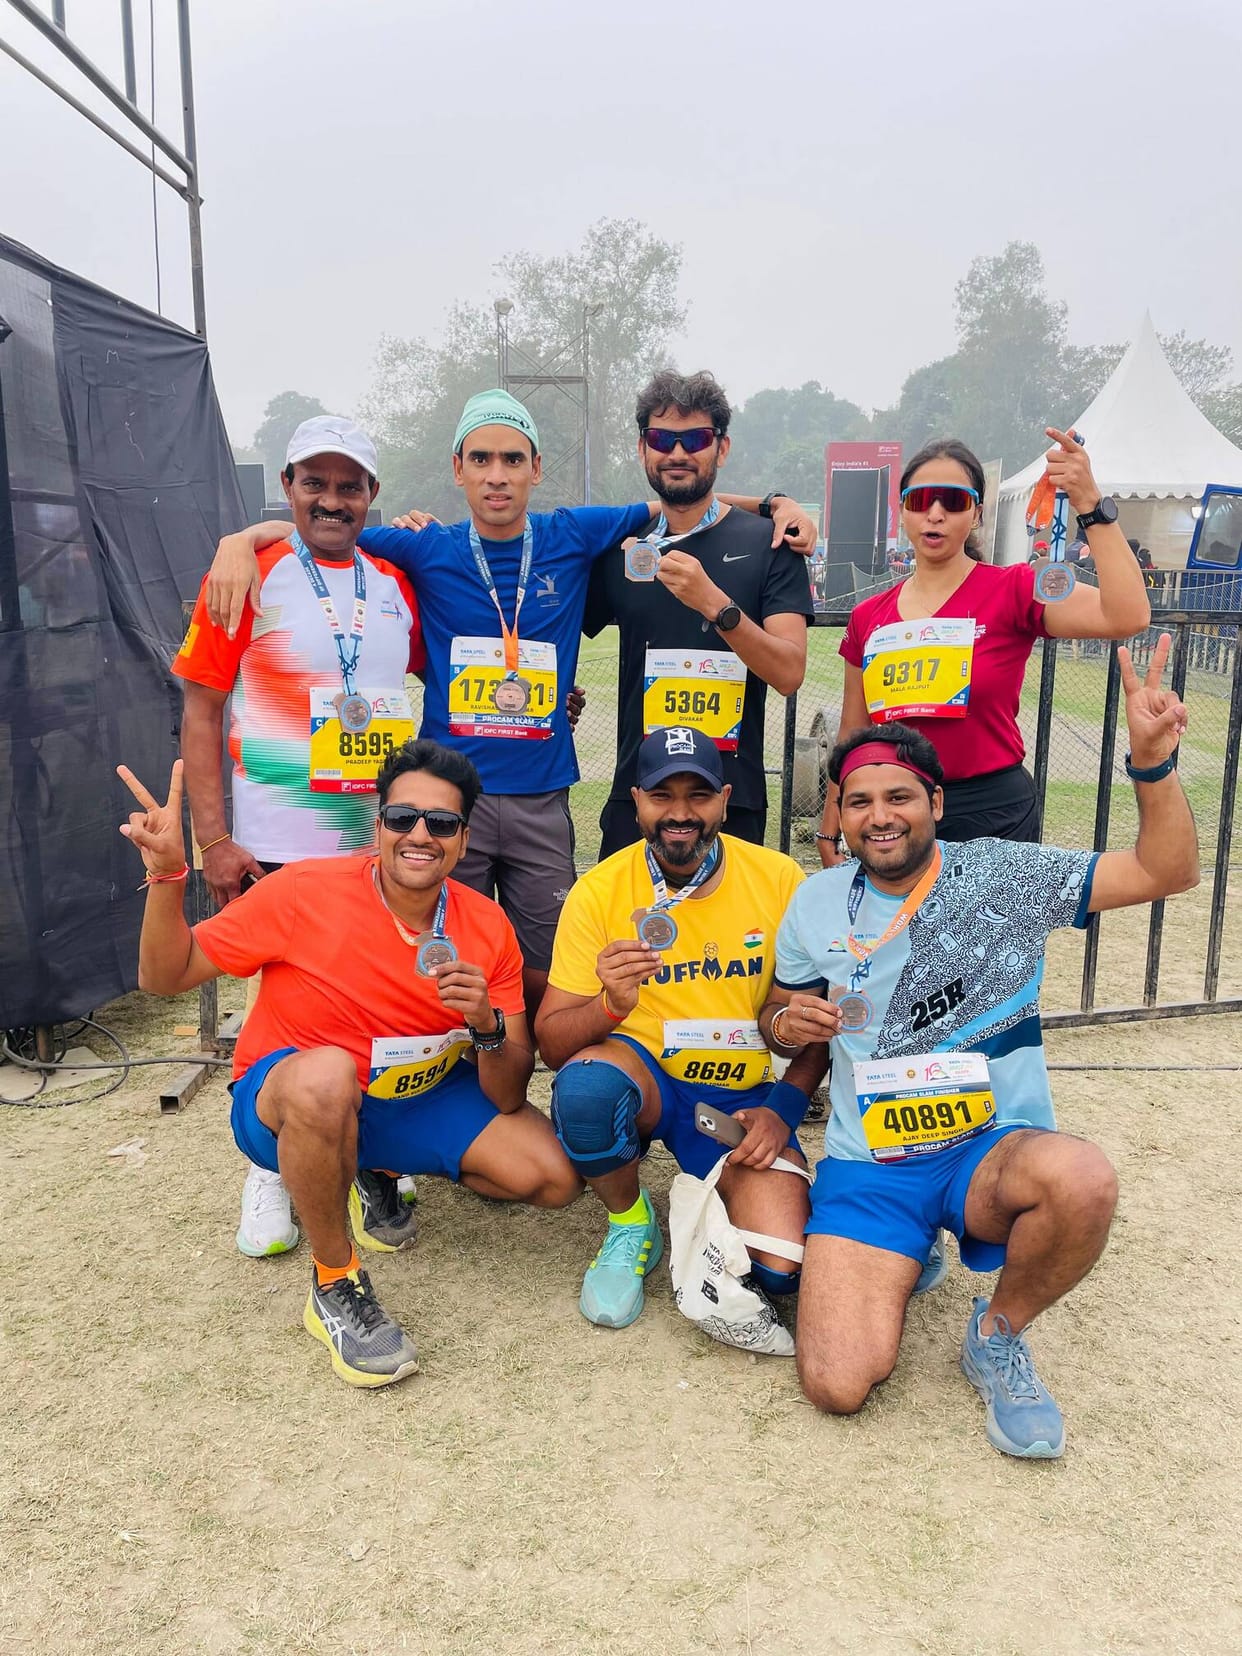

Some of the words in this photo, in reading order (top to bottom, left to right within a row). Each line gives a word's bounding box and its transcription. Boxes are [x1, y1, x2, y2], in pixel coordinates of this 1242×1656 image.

[883, 658, 940, 686] 9317
[459, 678, 545, 705] 1731
[665, 690, 720, 715] 5364
[340, 732, 393, 756] 8595
[642, 956, 763, 986] UFFMAN
[911, 977, 966, 1032] 25K
[395, 1056, 448, 1094] 8594
[684, 1061, 747, 1081] 8694
[864, 1097, 871, 1105] A
[884, 1101, 972, 1133] 40891
[942, 1128, 964, 1136] SINGH
[913, 1141, 949, 1152] PROCAM
